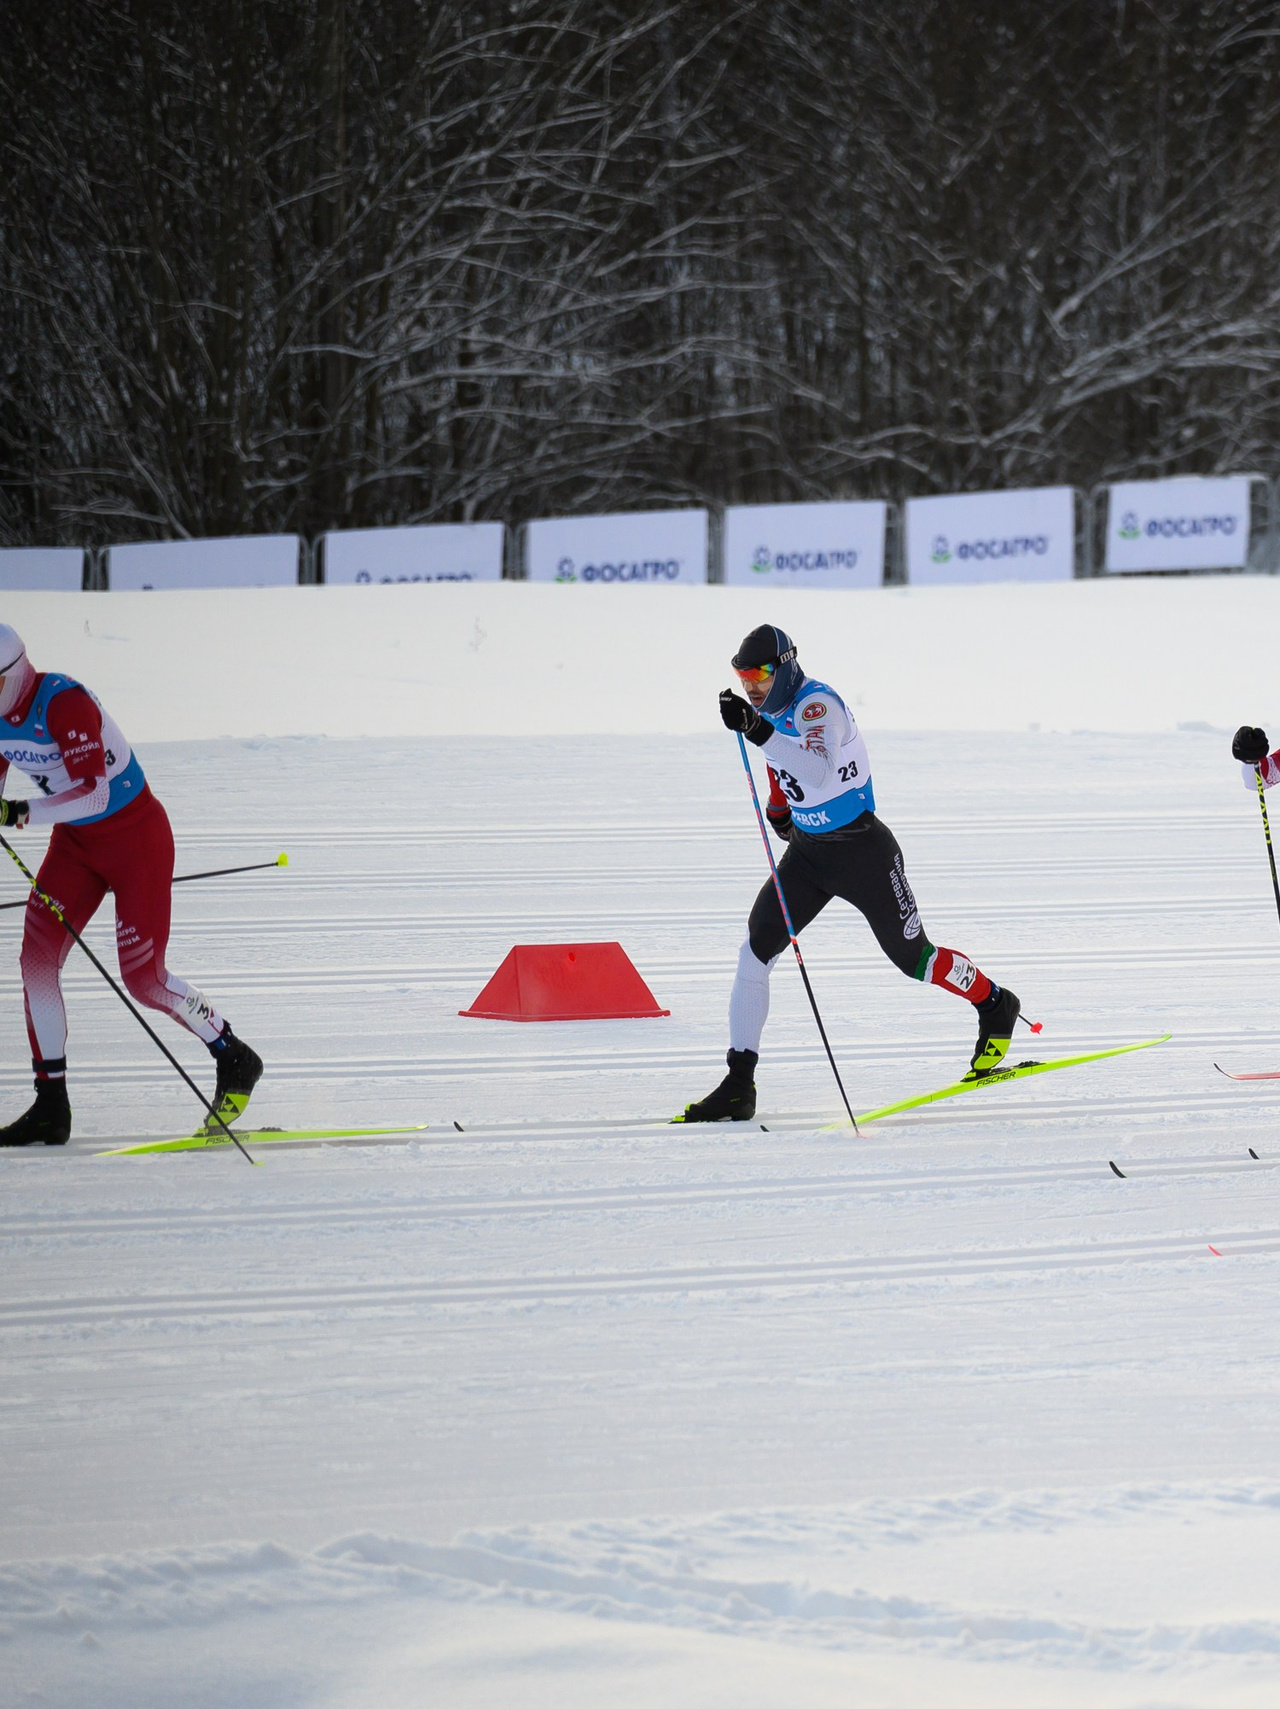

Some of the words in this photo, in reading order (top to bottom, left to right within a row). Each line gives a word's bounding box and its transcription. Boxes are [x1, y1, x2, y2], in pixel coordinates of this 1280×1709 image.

[1146, 516, 1237, 538] ФОСАГРО
[957, 536, 1047, 560] ФОСАГРО
[582, 560, 679, 582] ФОСАГРО
[776, 550, 857, 571] ФОСАГРО
[4, 750, 62, 763] ФОСАГРО
[63, 741, 100, 758] ЛУКОЙЛ
[837, 760, 858, 783] 23
[889, 869, 910, 920] Сетевая
[960, 963, 976, 989] 23
[197, 1003, 209, 1020] 3
[976, 1071, 1017, 1087] FISCHER
